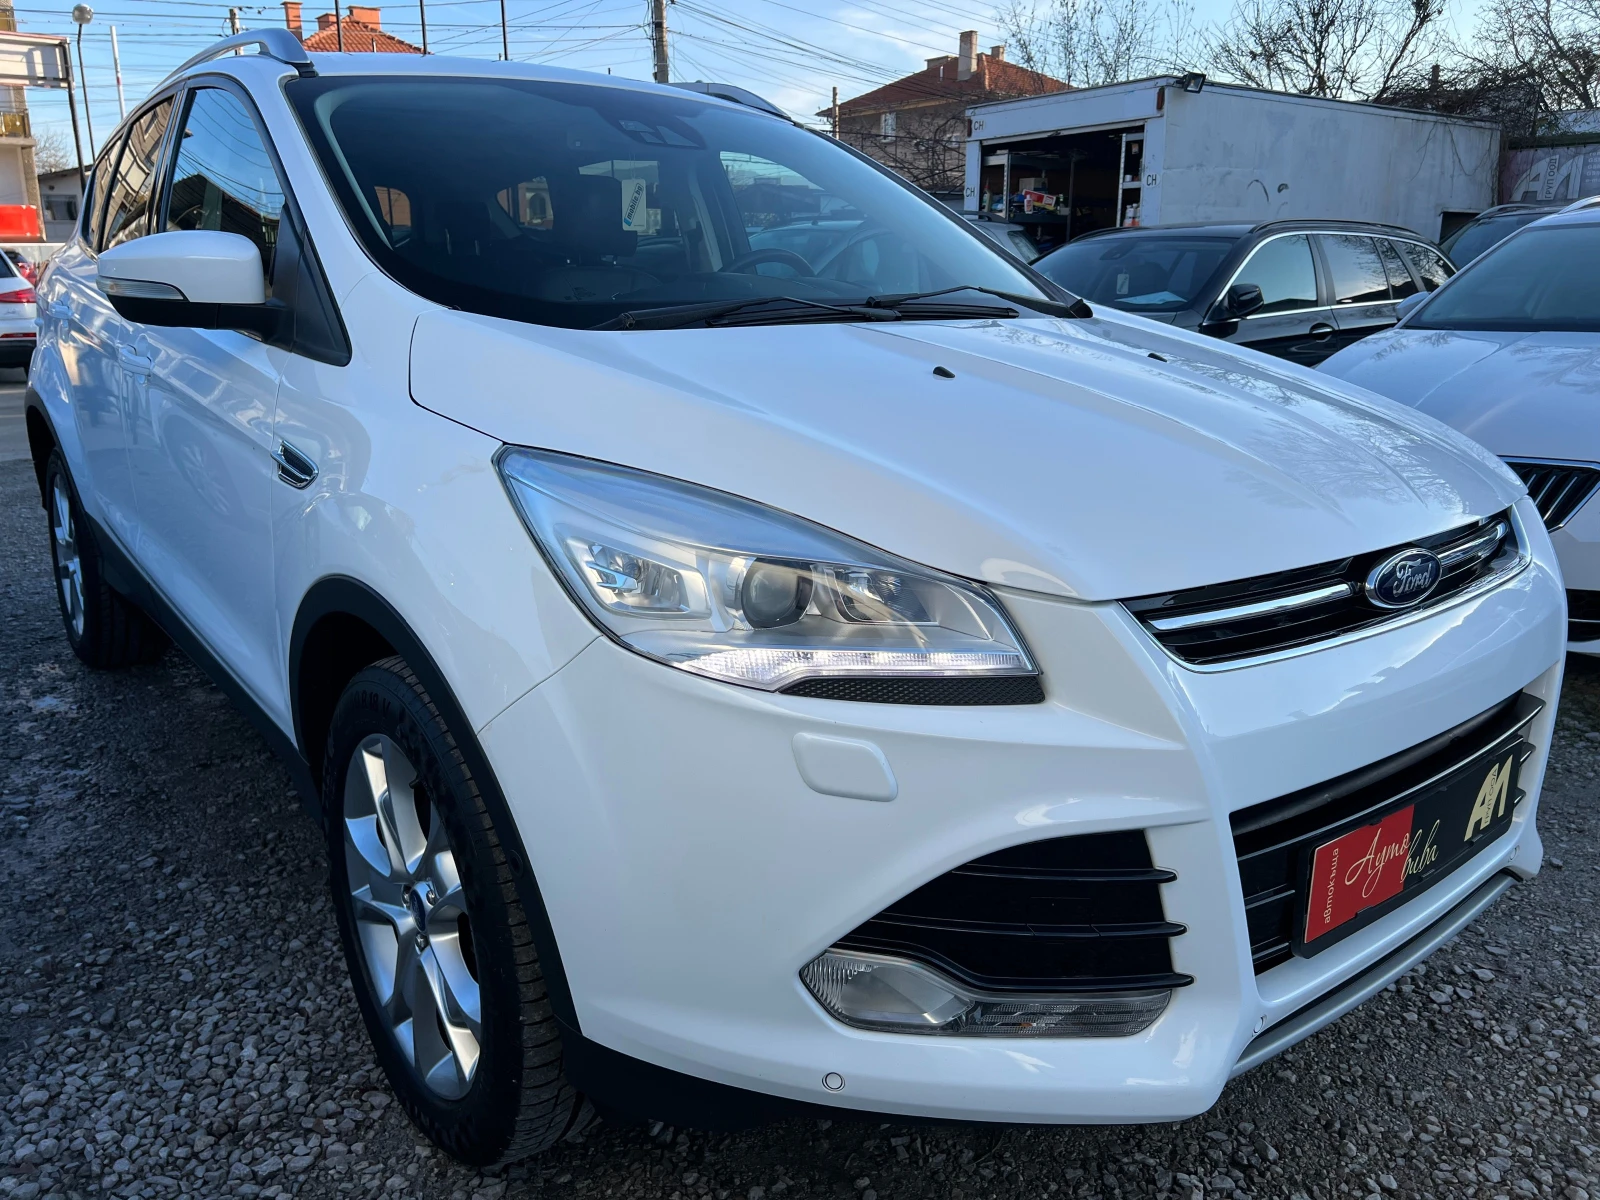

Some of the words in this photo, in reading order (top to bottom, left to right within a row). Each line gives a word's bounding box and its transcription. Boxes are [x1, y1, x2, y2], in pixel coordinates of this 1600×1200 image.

[973, 120, 984, 131] CH
[1146, 174, 1157, 187] CH
[965, 187, 976, 198] CH
[1544, 179, 1555, 199] ГРУП
[626, 185, 643, 220] mobile.bg
[1392, 558, 1432, 598] Ford
